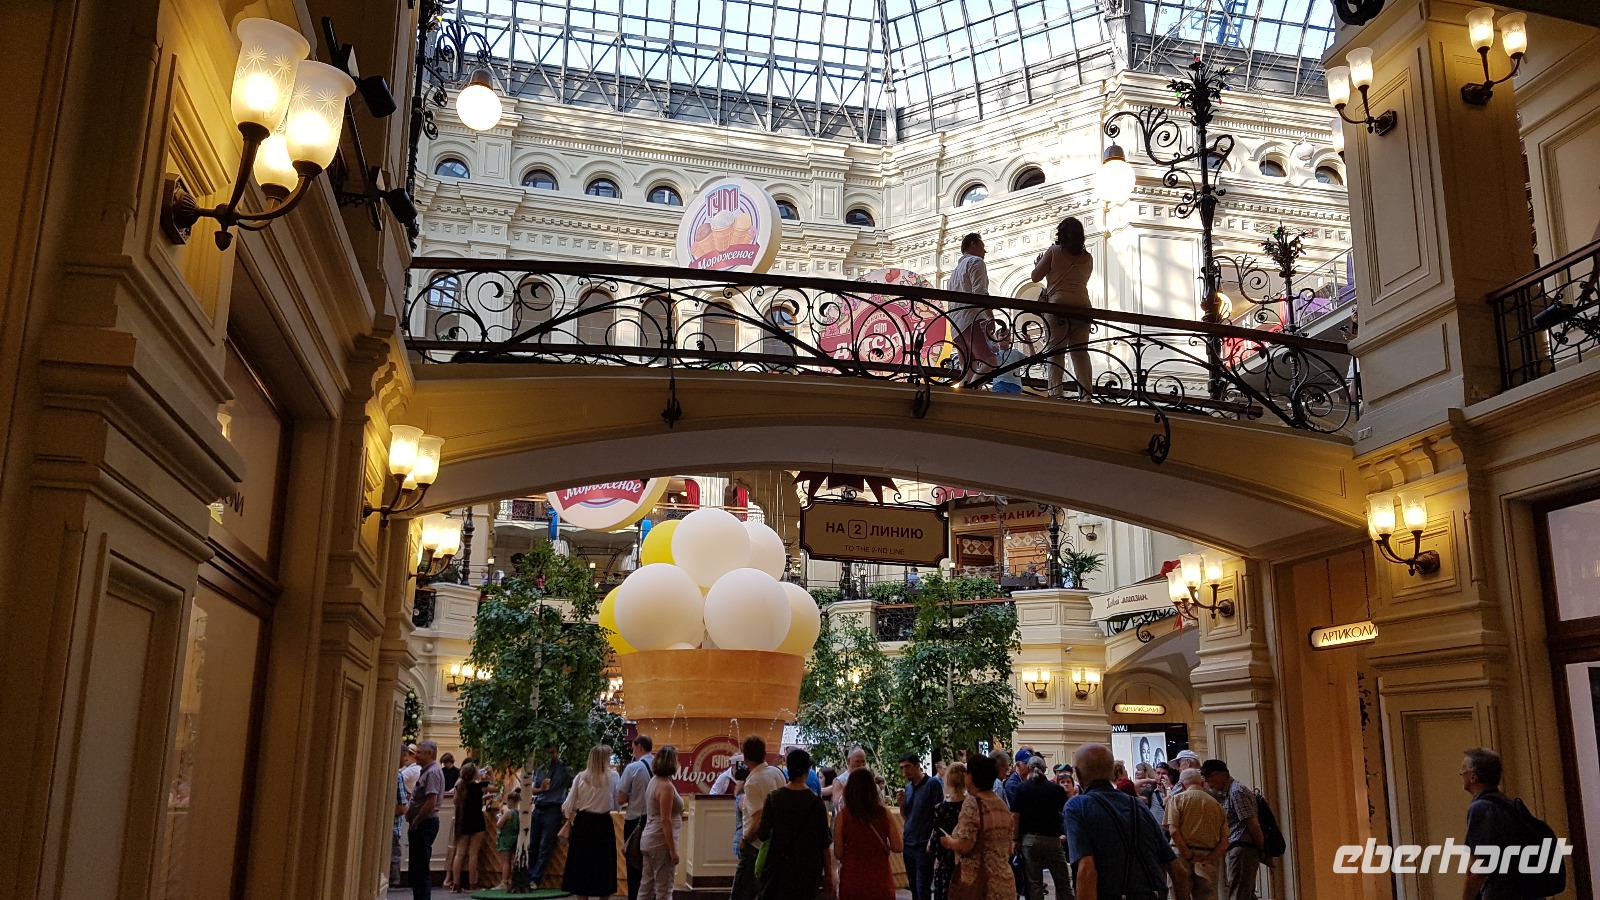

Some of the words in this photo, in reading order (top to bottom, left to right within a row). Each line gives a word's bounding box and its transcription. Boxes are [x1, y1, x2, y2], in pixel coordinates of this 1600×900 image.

[707, 187, 739, 219] ГУМ
[825, 521, 846, 534] НА
[853, 524, 862, 535] 2
[869, 525, 924, 540] ЛИНИЮ
[855, 545, 870, 553] THE
[1321, 625, 1378, 643] АРТИКОЛИ
